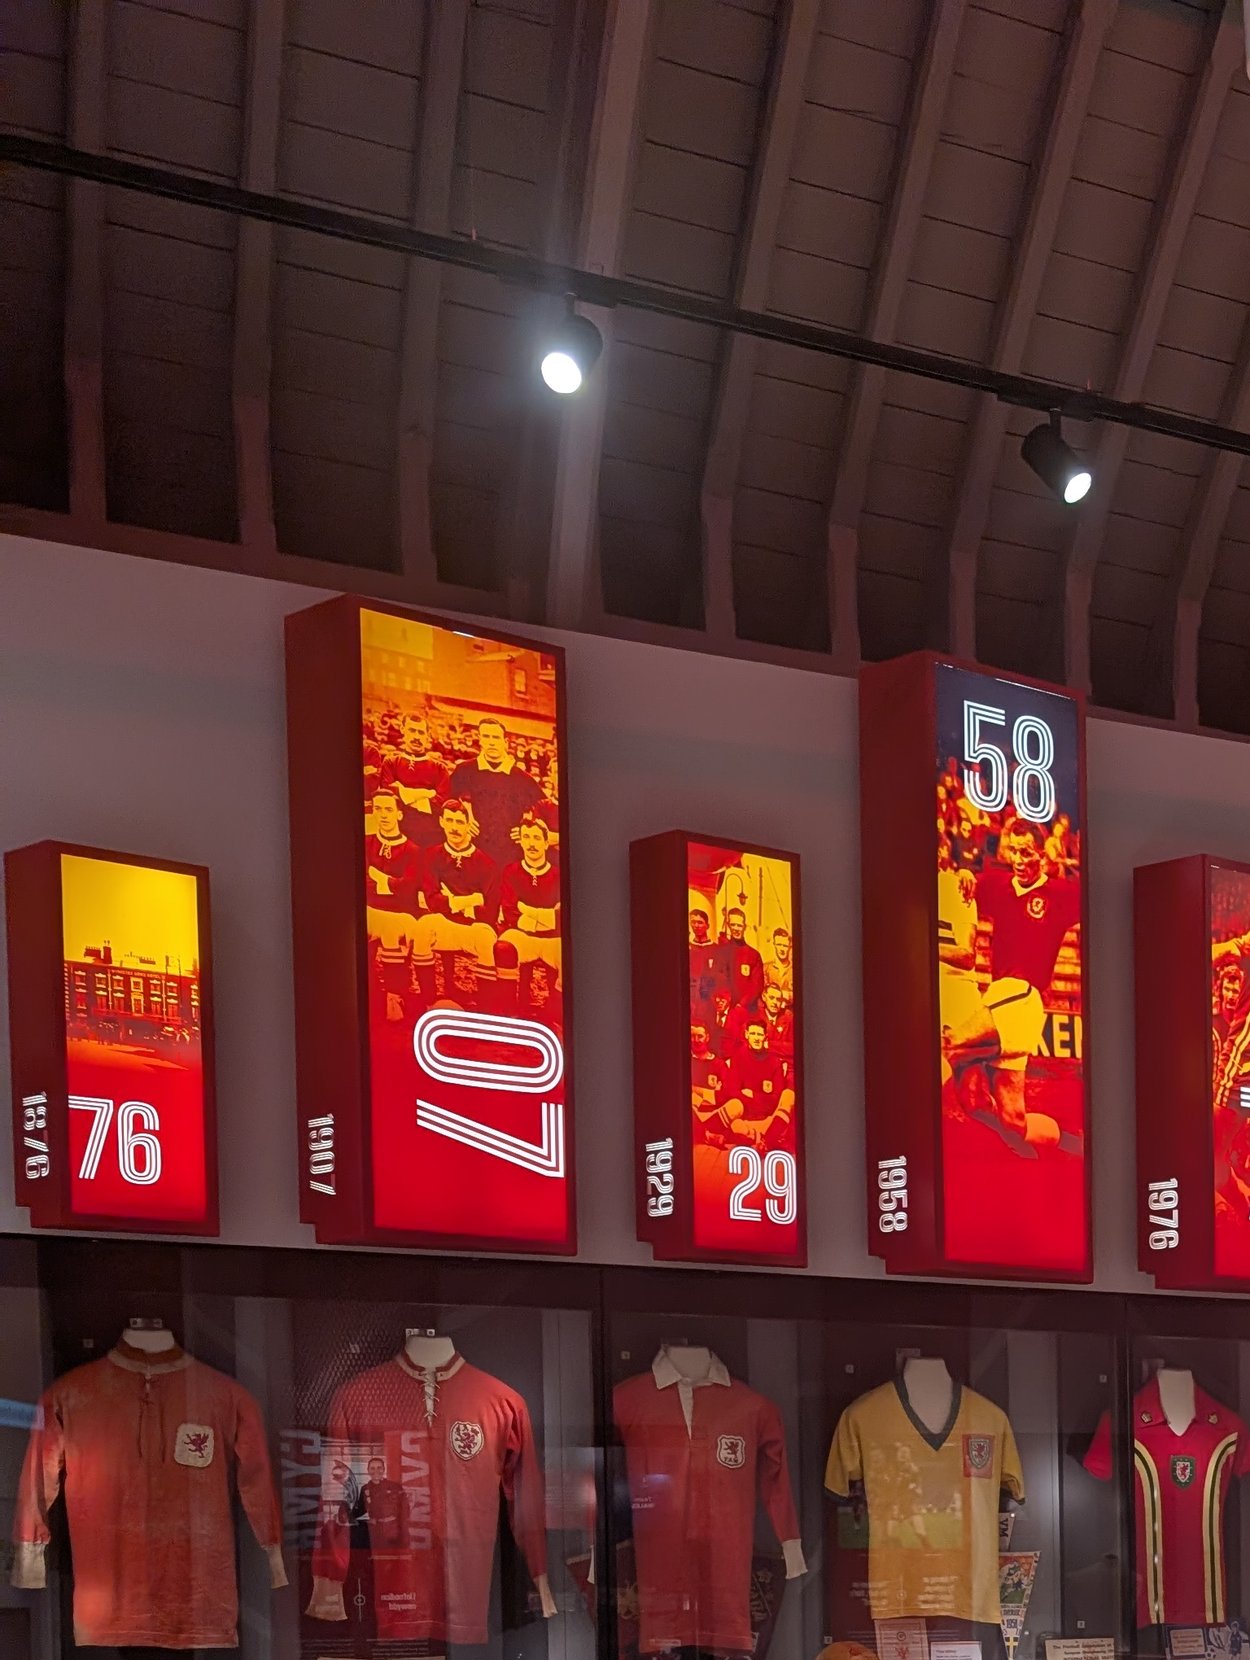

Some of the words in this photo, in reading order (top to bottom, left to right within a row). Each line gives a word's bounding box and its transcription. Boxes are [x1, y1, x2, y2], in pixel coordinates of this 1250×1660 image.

[964, 700, 1055, 823] 58
[413, 1008, 565, 1178] 07
[22, 1091, 50, 1179] 1876
[68, 1095, 162, 1185] 76
[308, 1113, 337, 1196] 1907
[646, 1137, 674, 1217] 1929
[728, 1146, 797, 1225] 29
[879, 1155, 908, 1233] 1958
[1148, 1177, 1179, 1250] 1976
